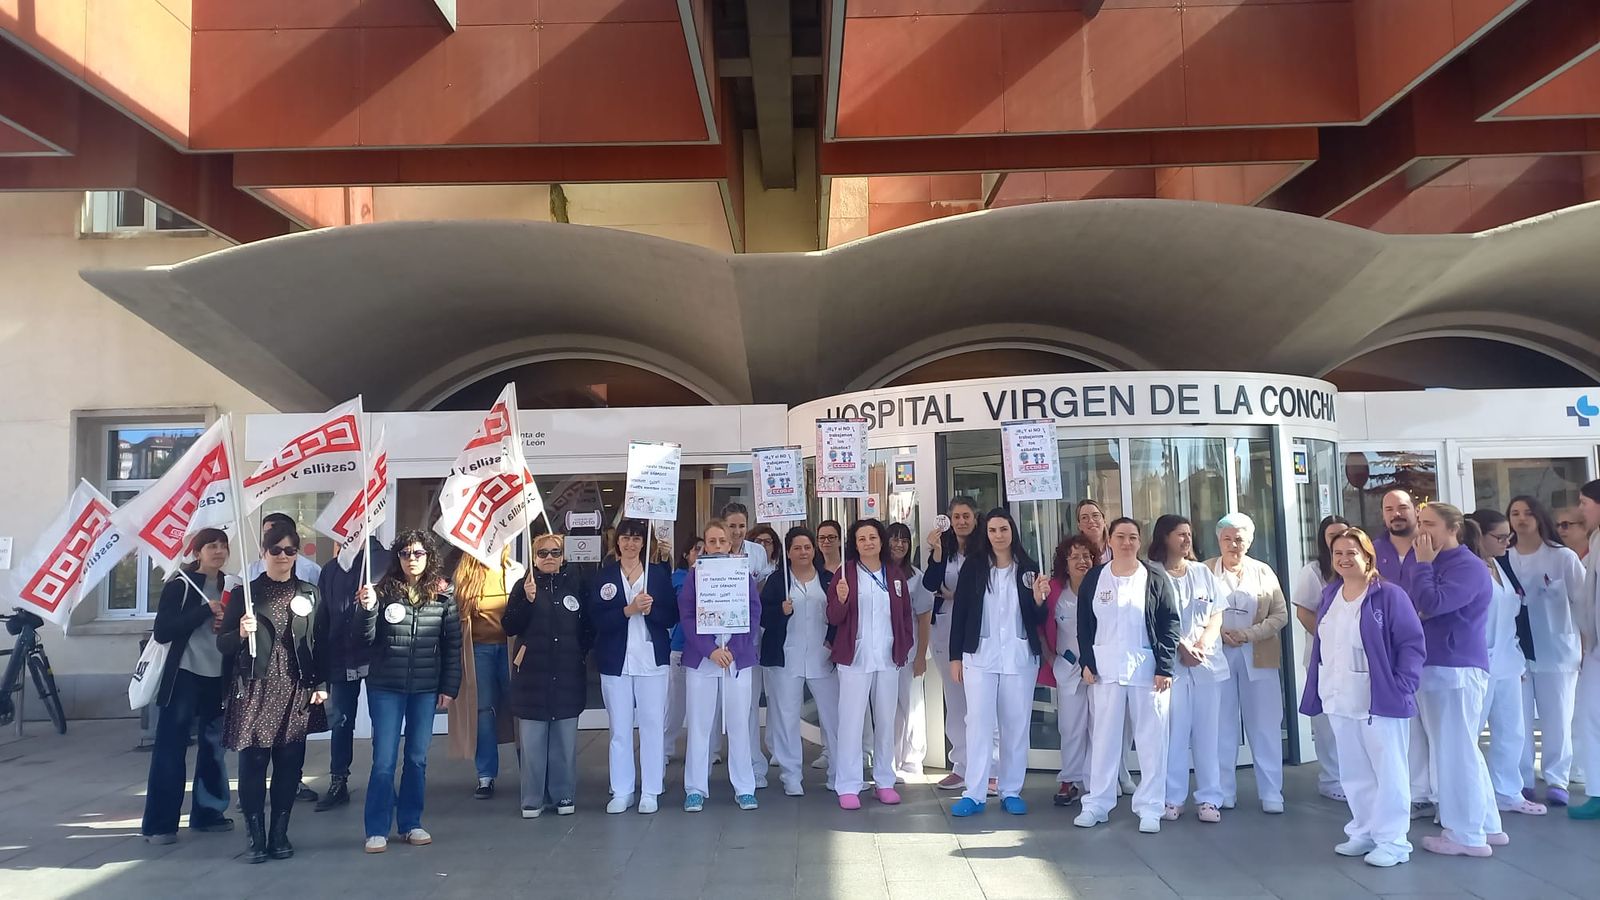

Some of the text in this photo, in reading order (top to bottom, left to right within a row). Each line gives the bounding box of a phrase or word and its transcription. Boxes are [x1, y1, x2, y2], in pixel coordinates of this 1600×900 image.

[982, 385, 1135, 421] VIRGEN
[1150, 384, 1200, 415] DE
[1214, 384, 1253, 415] LA
[1260, 385, 1336, 423] CONCHA
[526, 439, 546, 447] León
